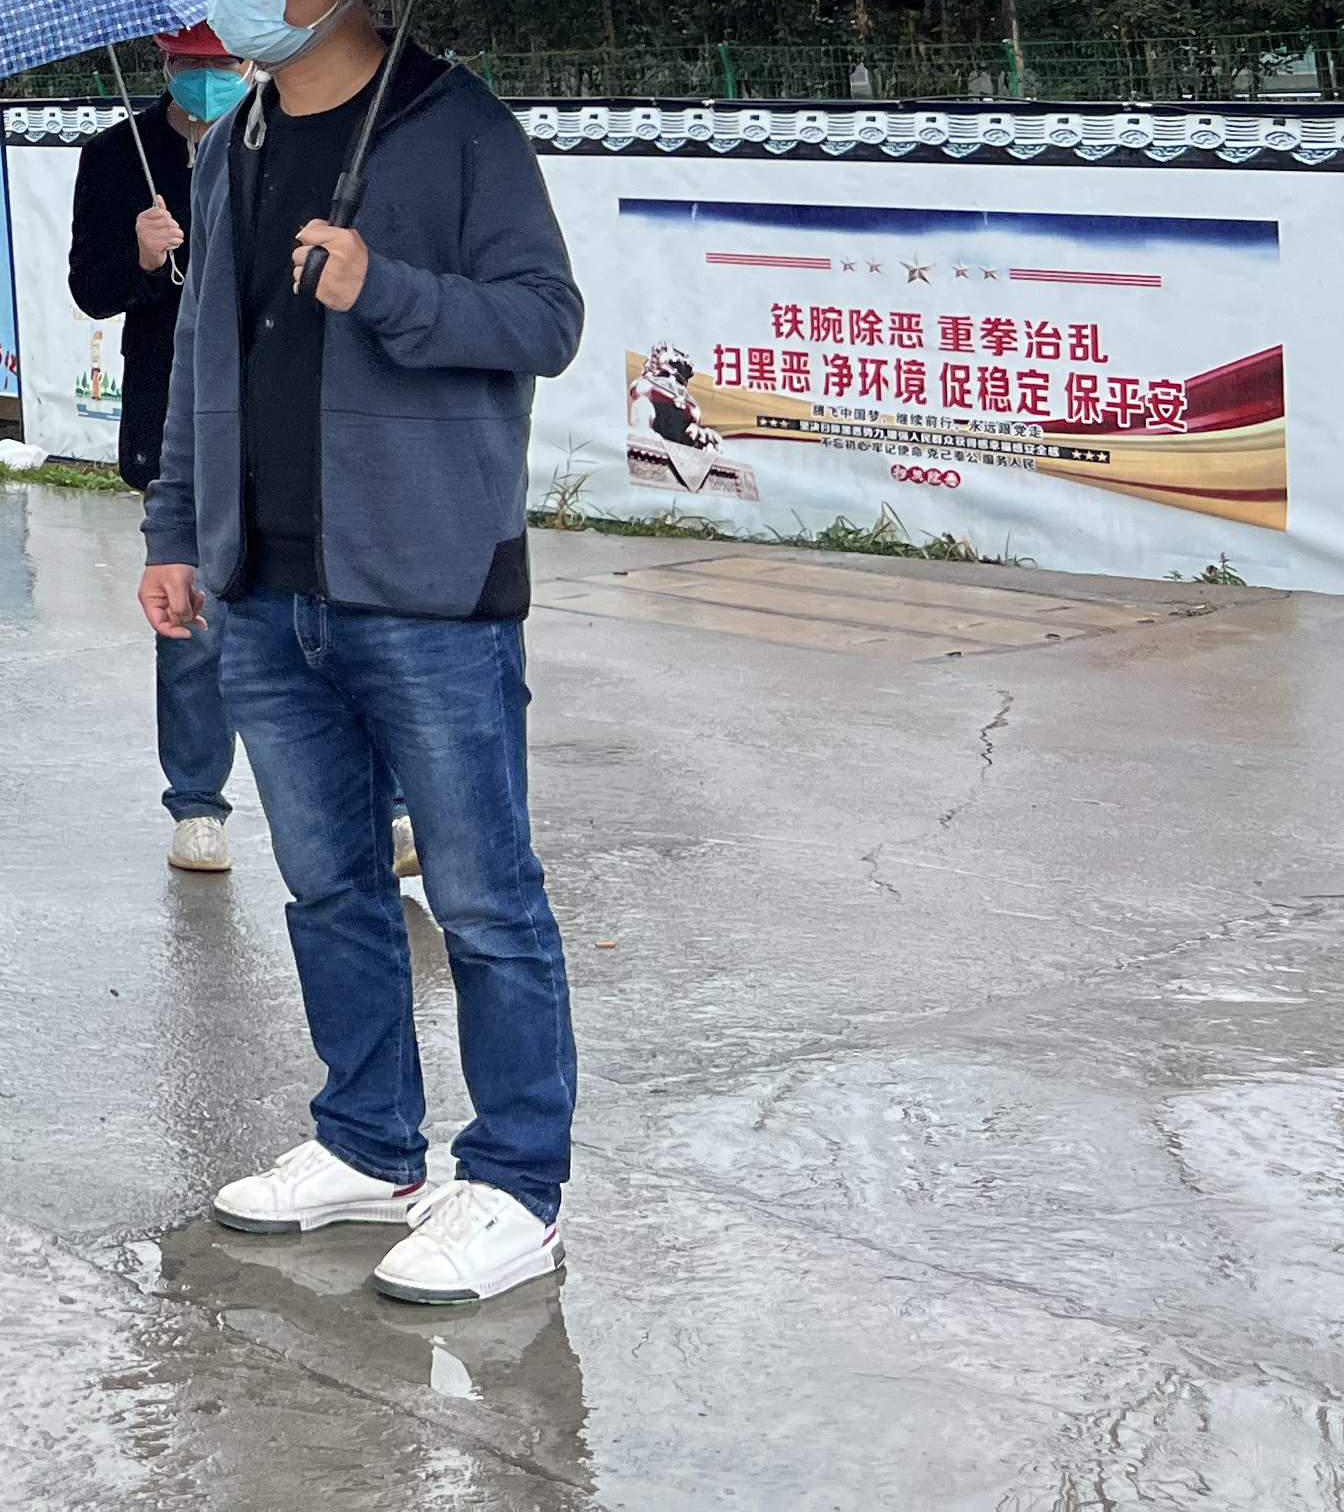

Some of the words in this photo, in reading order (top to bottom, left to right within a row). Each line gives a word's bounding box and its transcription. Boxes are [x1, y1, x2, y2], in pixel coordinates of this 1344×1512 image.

[770, 303, 924, 349] 铁腕除恶
[937, 315, 1109, 364] 重拳治乱
[713, 343, 811, 394] 扫黑恶
[822, 353, 928, 406] 净环境
[939, 361, 1051, 417] 促稳定
[1064, 372, 1188, 431] 保平安
